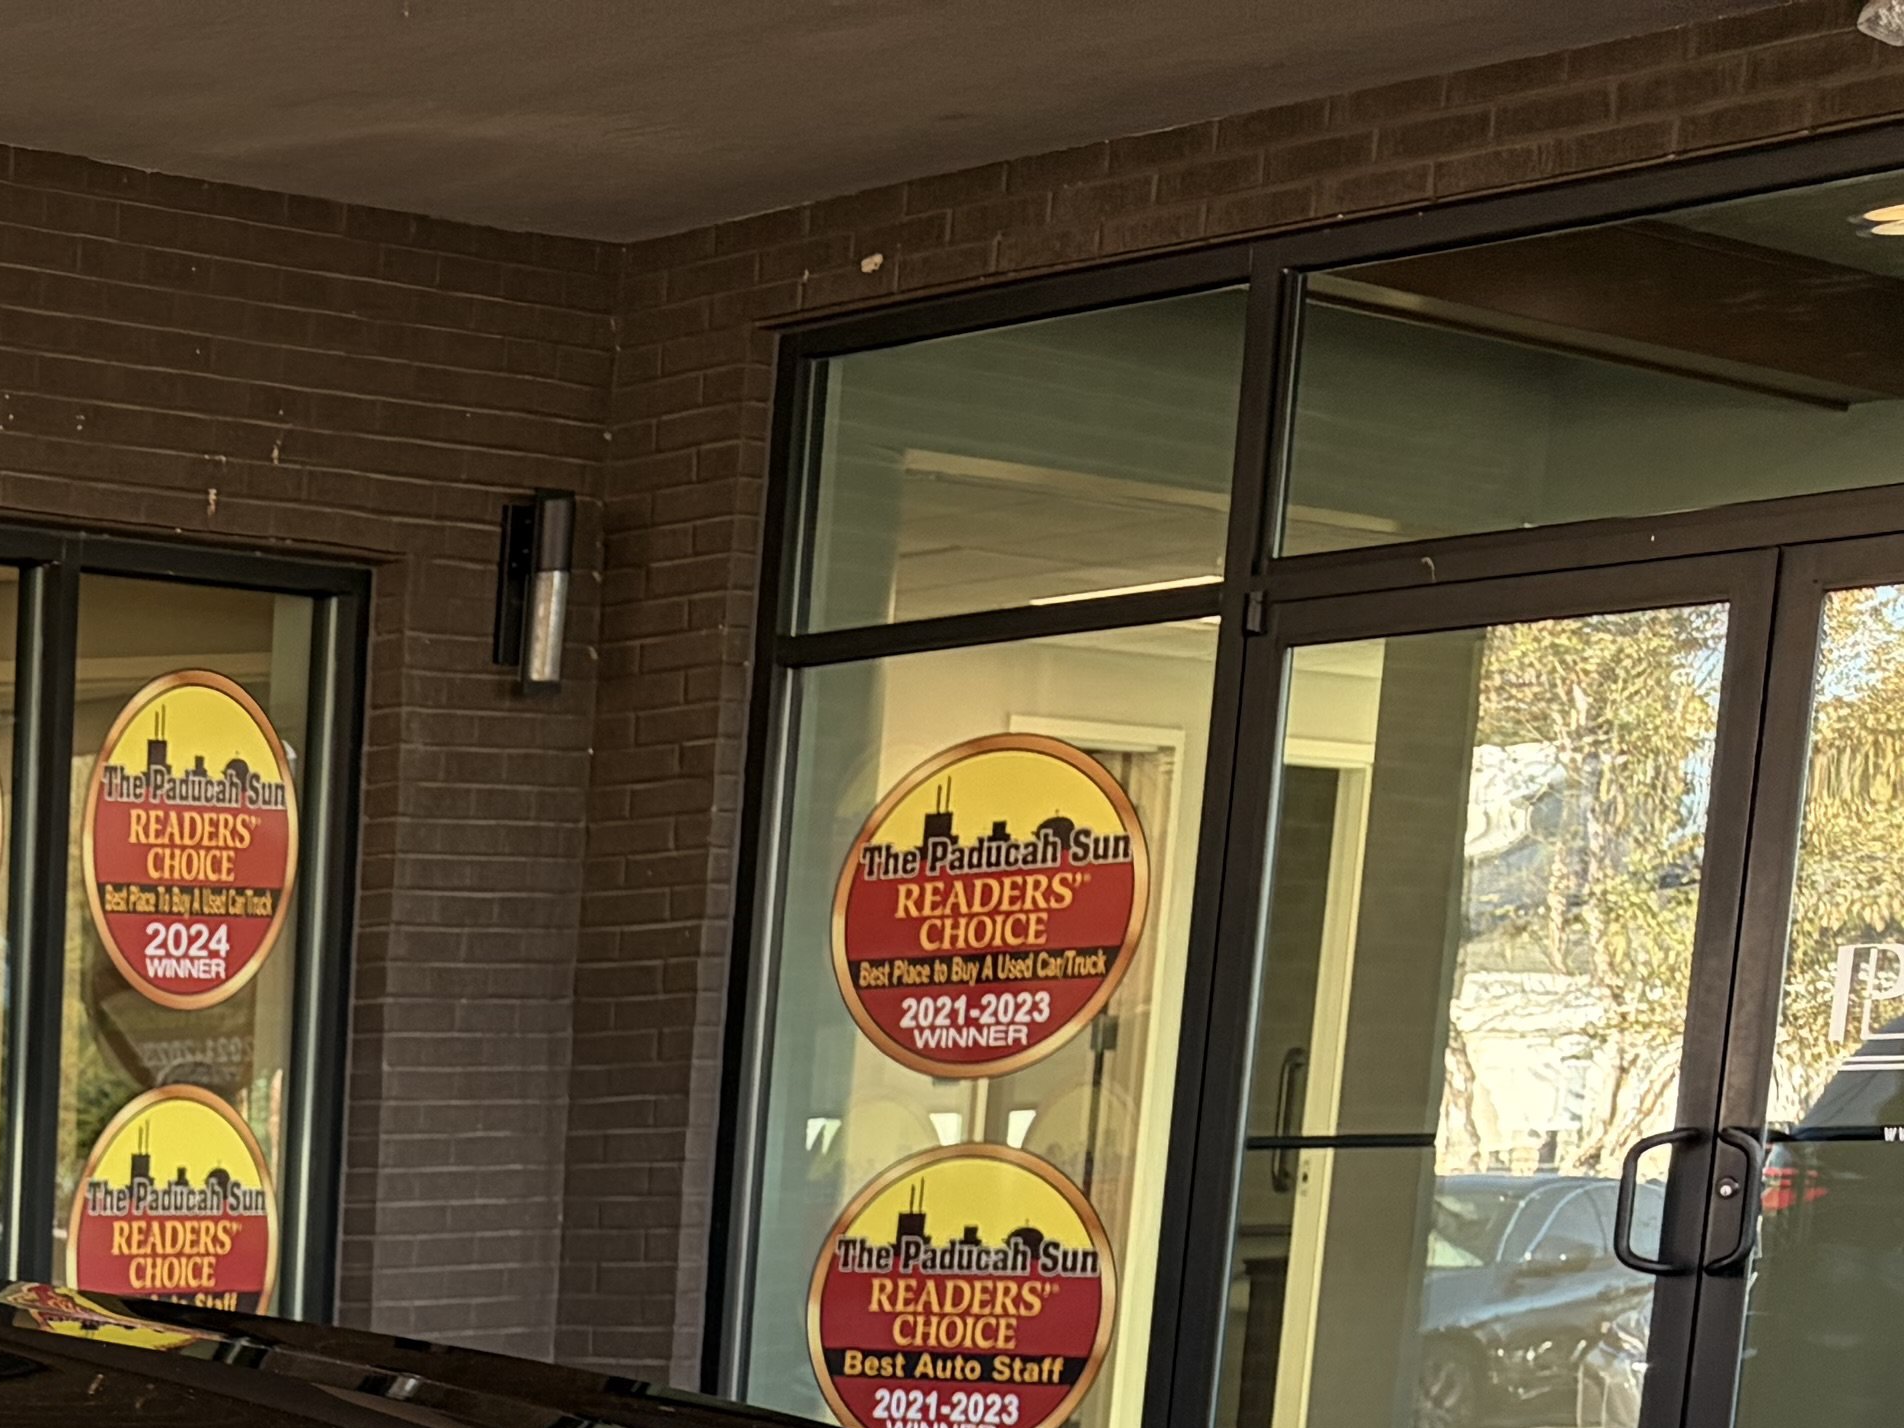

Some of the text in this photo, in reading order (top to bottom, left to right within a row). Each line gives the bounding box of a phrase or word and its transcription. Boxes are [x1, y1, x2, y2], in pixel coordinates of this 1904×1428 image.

[104, 765, 286, 809] The Paducah Sun
[147, 847, 235, 882] CHOICE
[861, 828, 1132, 880] The Paducah Sun
[105, 884, 128, 912] Best
[145, 922, 230, 957] 2024
[919, 912, 1049, 951] CHOICE
[145, 957, 226, 979] WINNER
[859, 949, 1107, 987] Best Place to Buy A Used Car/Truck
[899, 991, 1051, 1029] 2021-2023
[913, 1024, 1029, 1049] WINNER
[87, 1177, 267, 1216] The Paducah Sun
[129, 1256, 217, 1288] CHOICE
[837, 1236, 1100, 1276] The Paducah Sun
[893, 1314, 1017, 1349] CHOICE
[844, 1350, 1064, 1383] Best Auto Staff
[873, 1388, 1020, 1425] 2021-2023
